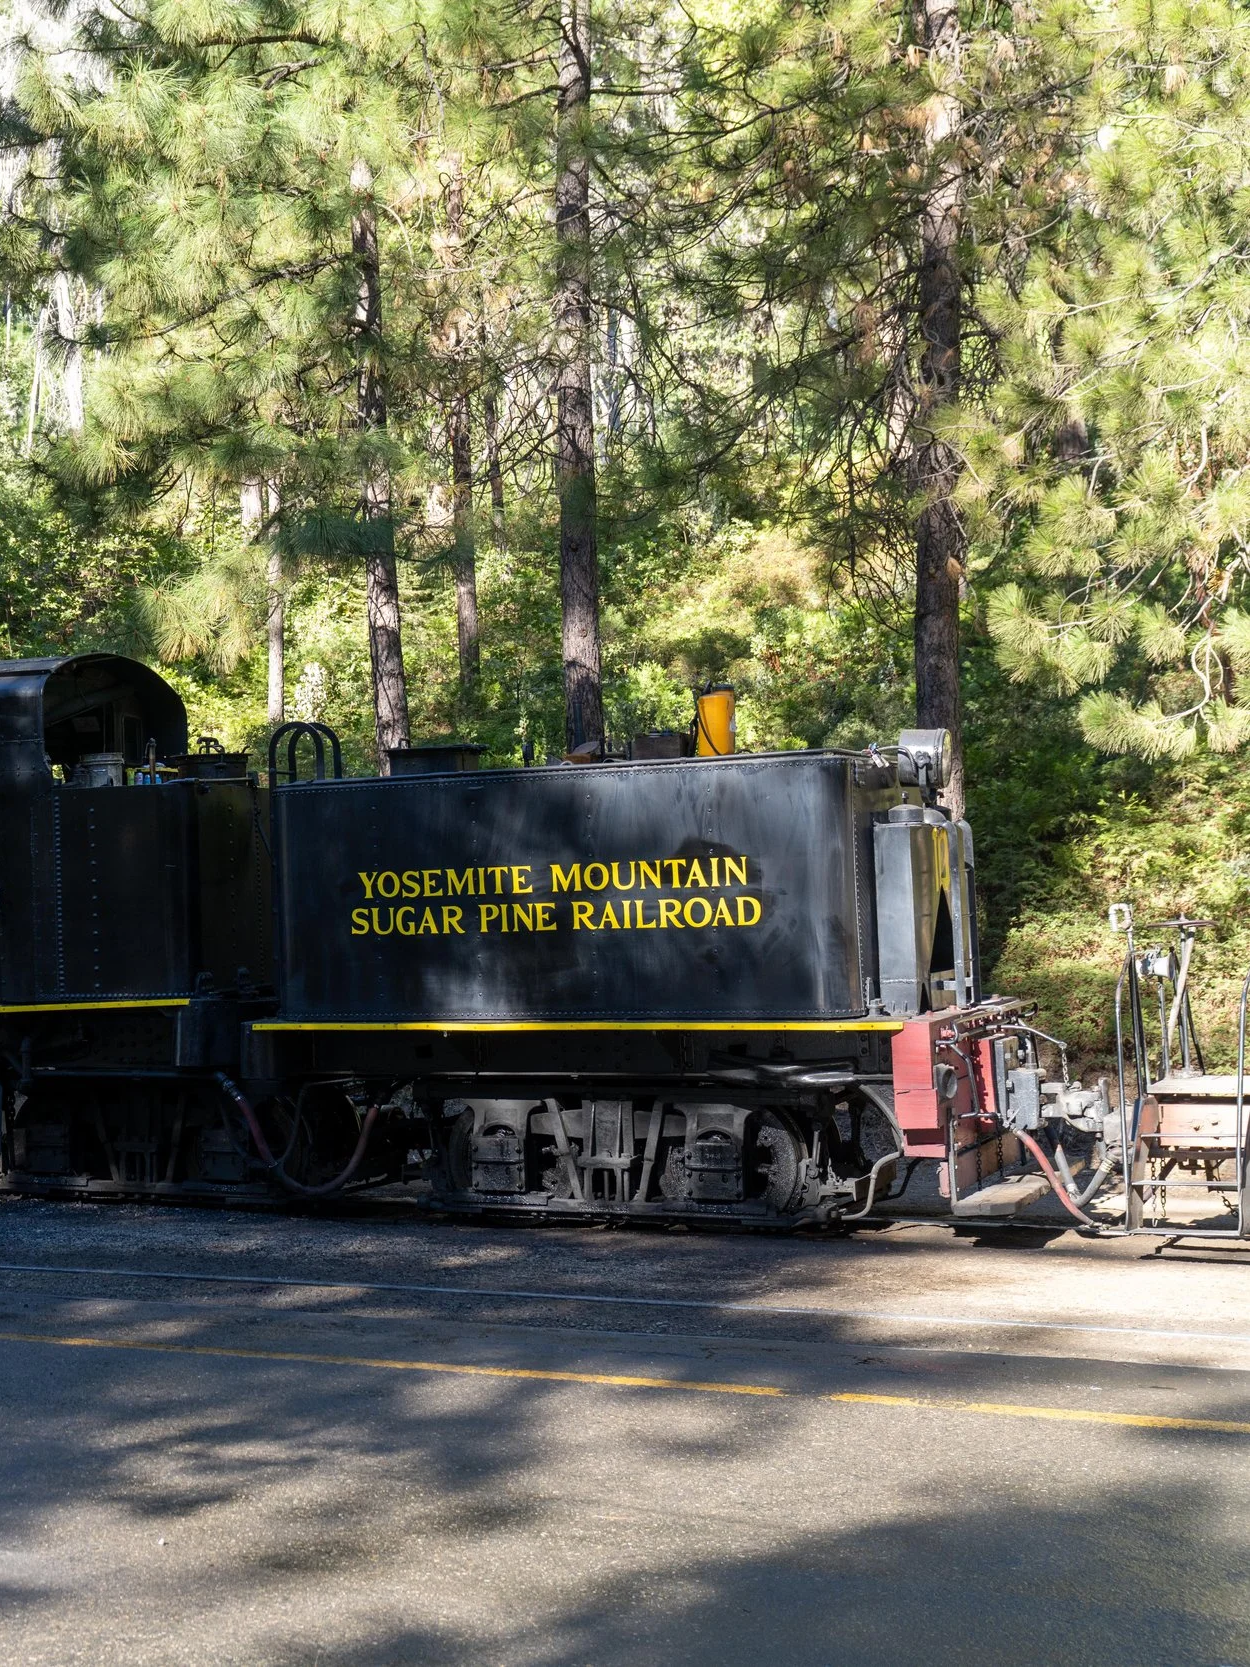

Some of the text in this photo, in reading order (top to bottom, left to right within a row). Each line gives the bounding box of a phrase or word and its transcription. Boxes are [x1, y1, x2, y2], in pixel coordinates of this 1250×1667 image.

[357, 855, 748, 899] YOSEMITE MOUNTAIN
[351, 895, 763, 936] SUGAR PINE RAILROAD
